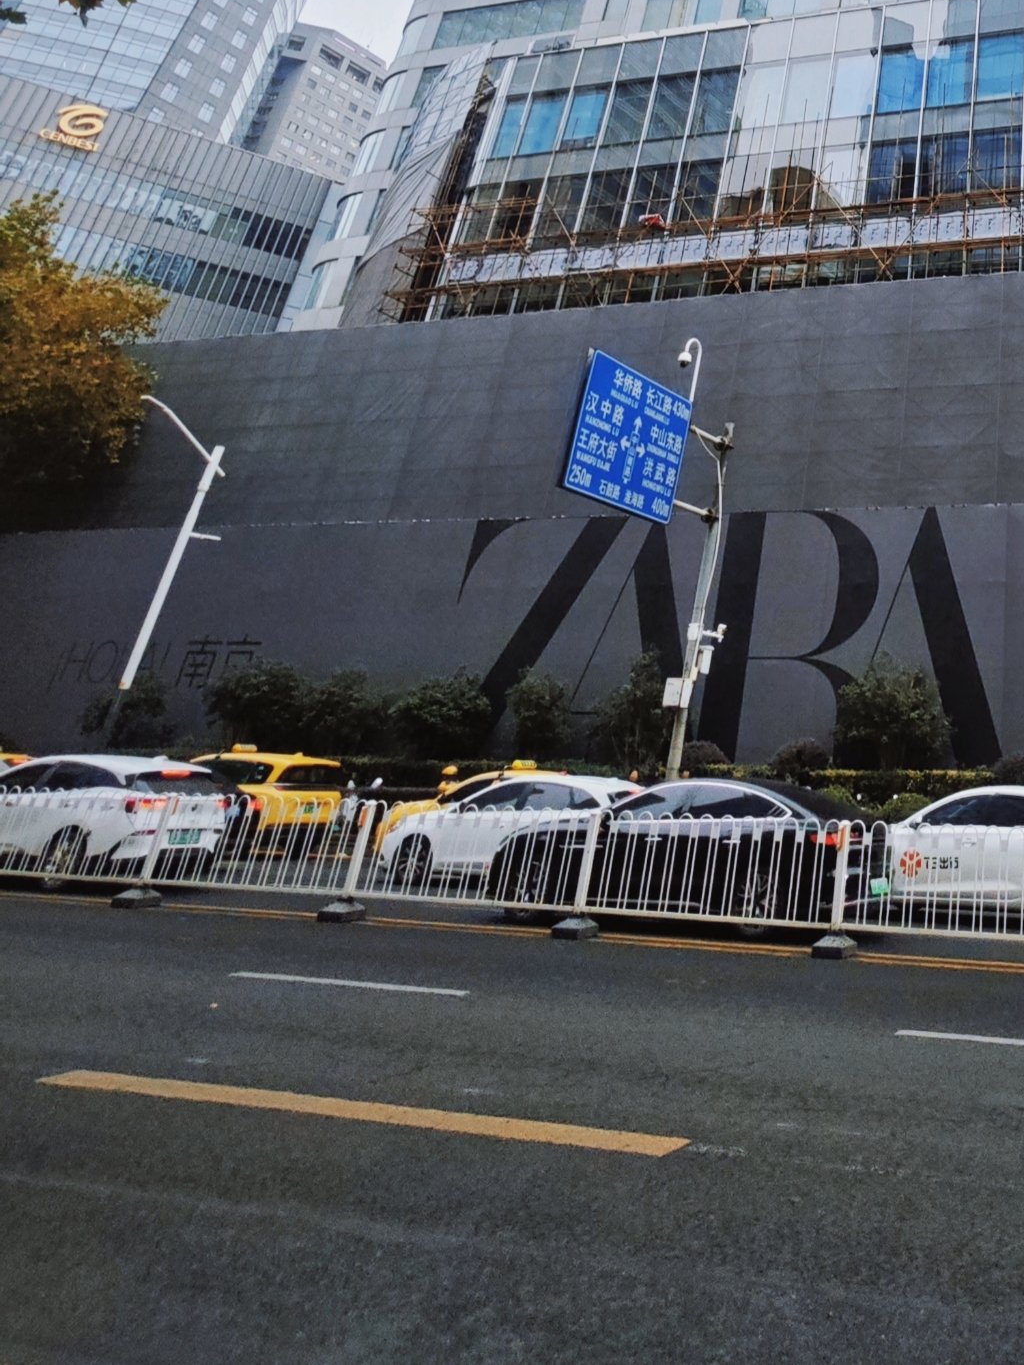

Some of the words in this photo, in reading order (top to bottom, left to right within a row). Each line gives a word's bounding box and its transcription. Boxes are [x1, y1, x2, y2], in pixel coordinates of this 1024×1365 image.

[39, 128, 99, 152] CENBEST
[613, 368, 643, 400] 华侨路
[585, 391, 624, 426] 汉中路
[646, 386, 672, 416] 长江路
[672, 400, 690, 420] 430m
[577, 429, 618, 462] 王府大街
[650, 424, 683, 454] 中山东路
[569, 465, 592, 488] 250m
[642, 458, 677, 487] 洪武路
[651, 497, 670, 517] 400m
[457, 506, 1003, 767] ZARA
